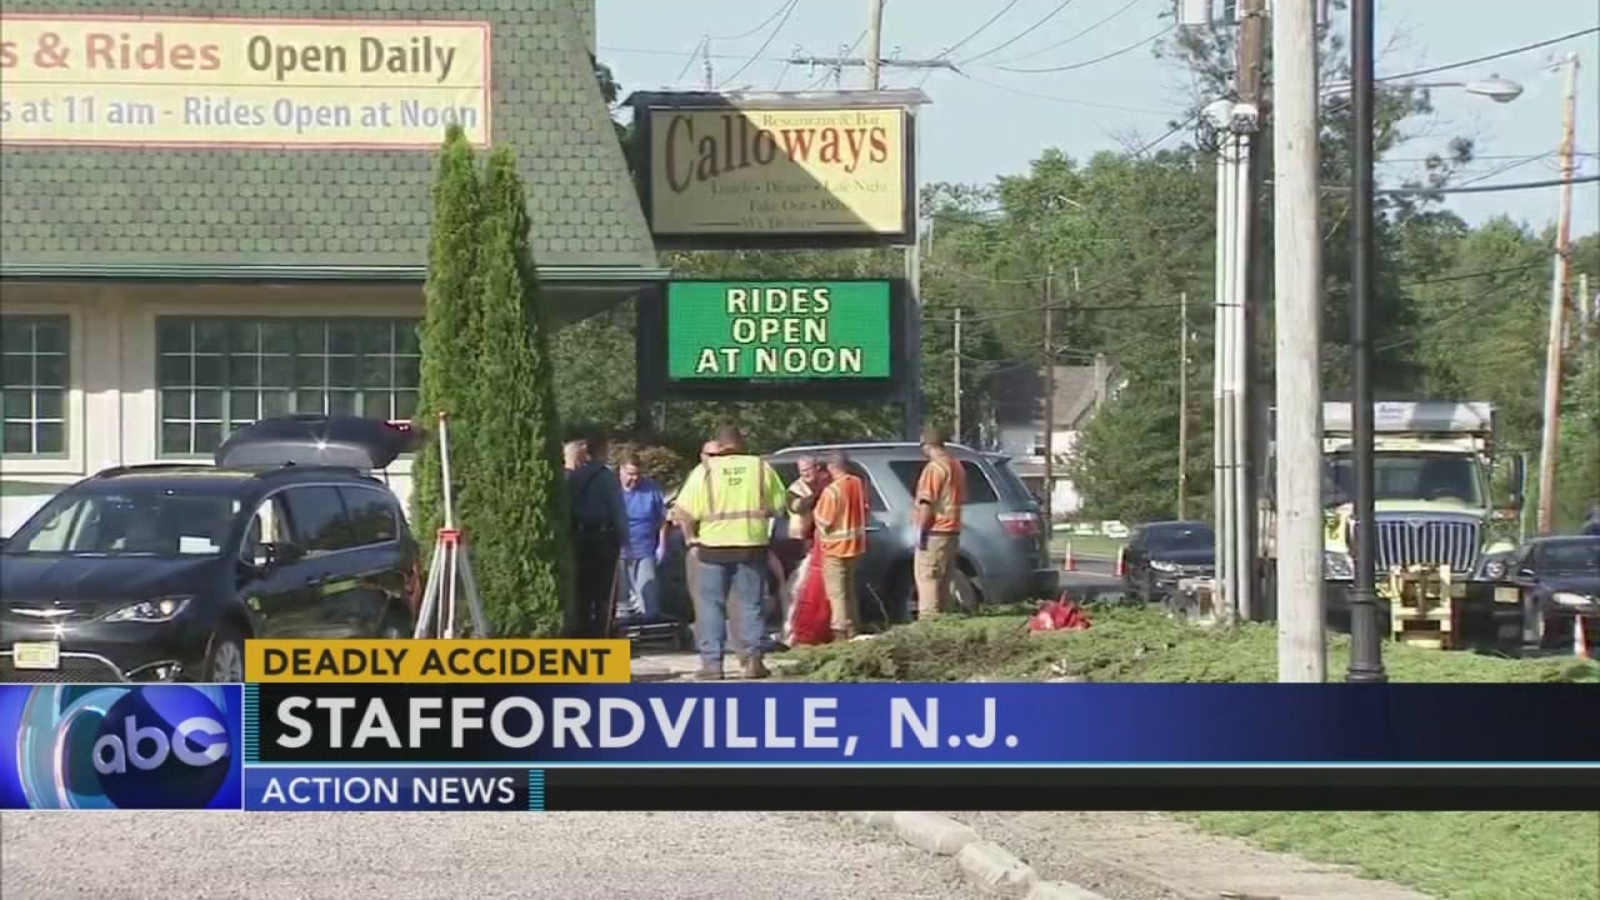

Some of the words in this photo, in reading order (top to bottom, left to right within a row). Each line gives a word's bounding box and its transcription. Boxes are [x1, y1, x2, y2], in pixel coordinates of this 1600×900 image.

[33, 32, 70, 69] &
[85, 33, 222, 71] Rides
[247, 34, 347, 81] Open
[359, 36, 456, 83] Daily
[21, 98, 53, 123] at
[64, 96, 96, 124] 11
[107, 102, 155, 125] am
[183, 96, 266, 126] Rides
[273, 98, 351, 134] Open
[360, 102, 392, 127] at
[400, 99, 478, 128] Noon
[665, 112, 888, 194] Calloways
[727, 288, 830, 314] RIDES
[732, 317, 827, 344] OPEN
[696, 348, 741, 374] AT
[755, 347, 862, 374] NOON
